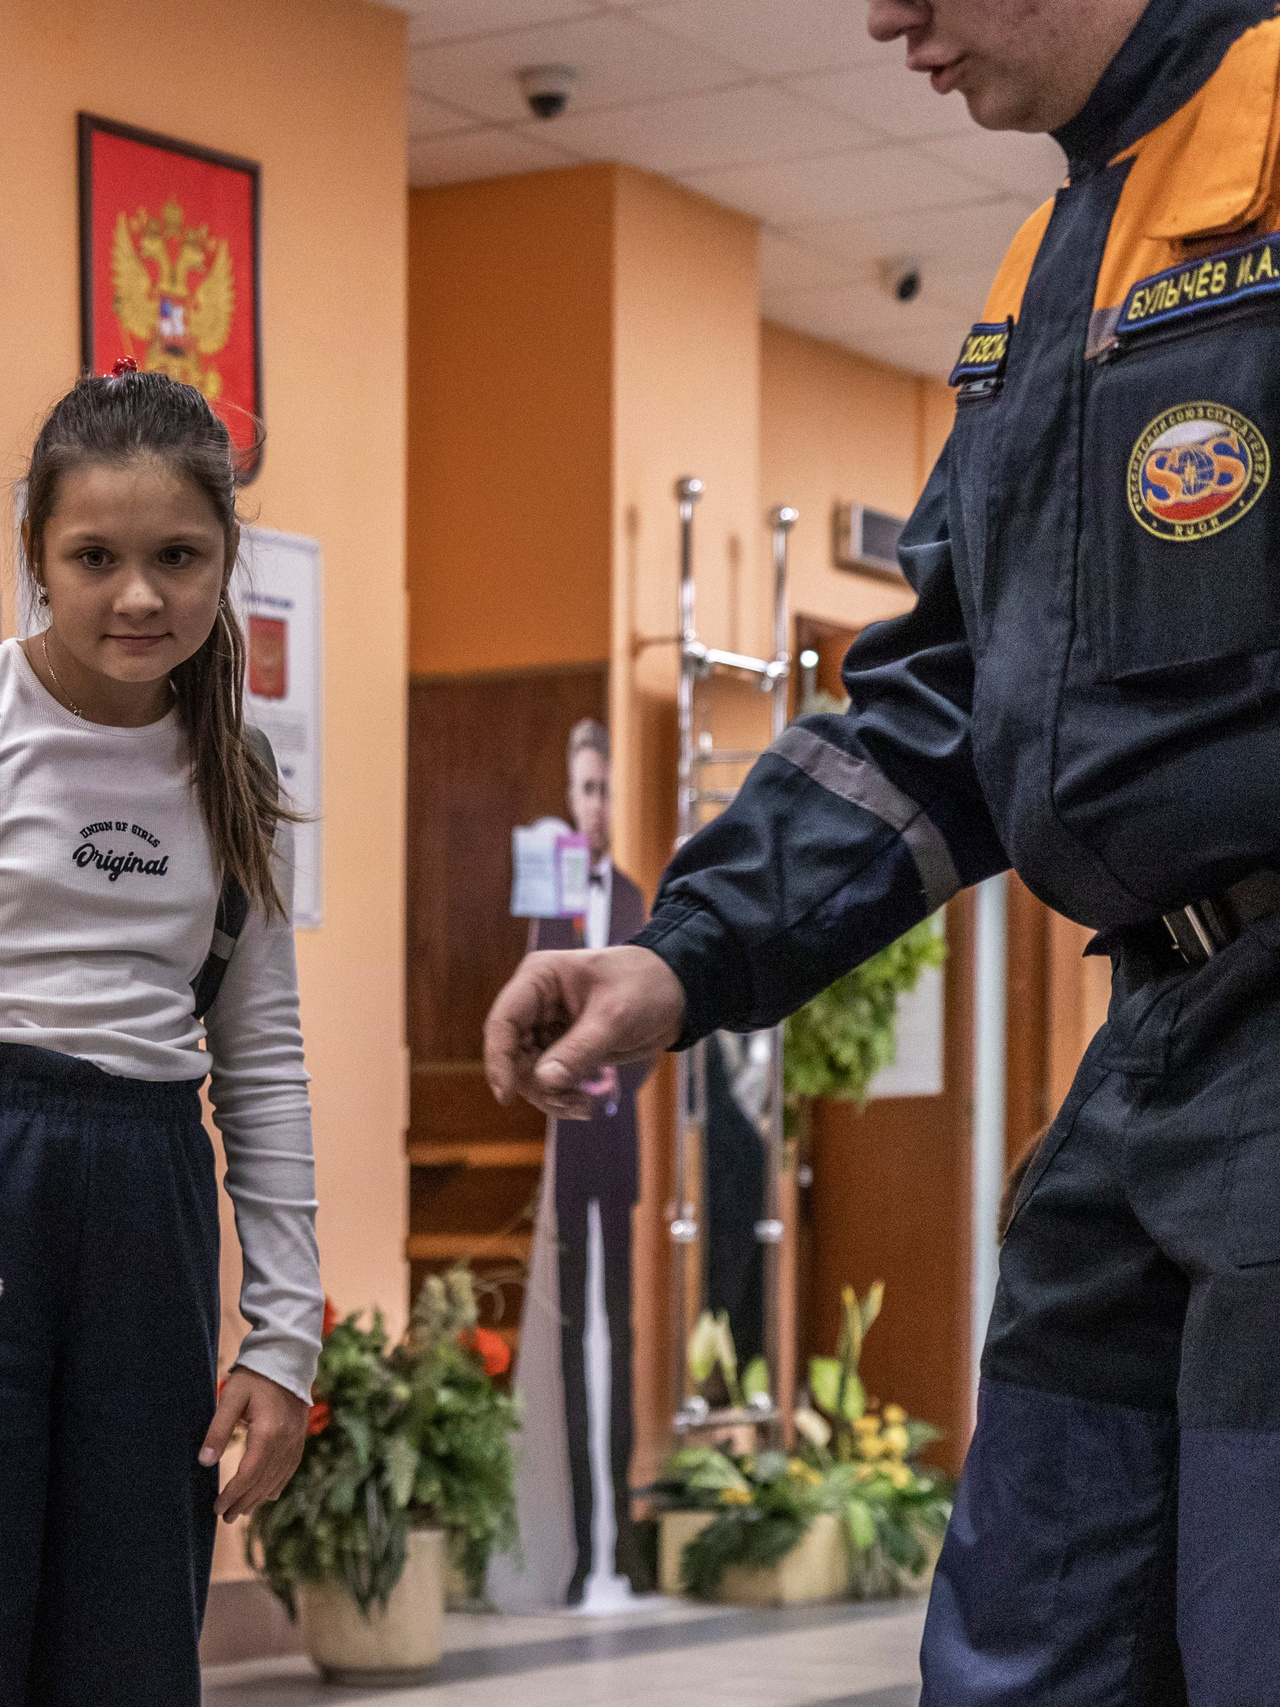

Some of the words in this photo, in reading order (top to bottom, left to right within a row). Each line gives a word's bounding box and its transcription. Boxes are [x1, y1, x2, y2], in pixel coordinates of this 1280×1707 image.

[79, 821, 113, 839] UNION
[115, 821, 129, 832] OF
[131, 824, 161, 848] GIRLS
[72, 843, 169, 881] Original
